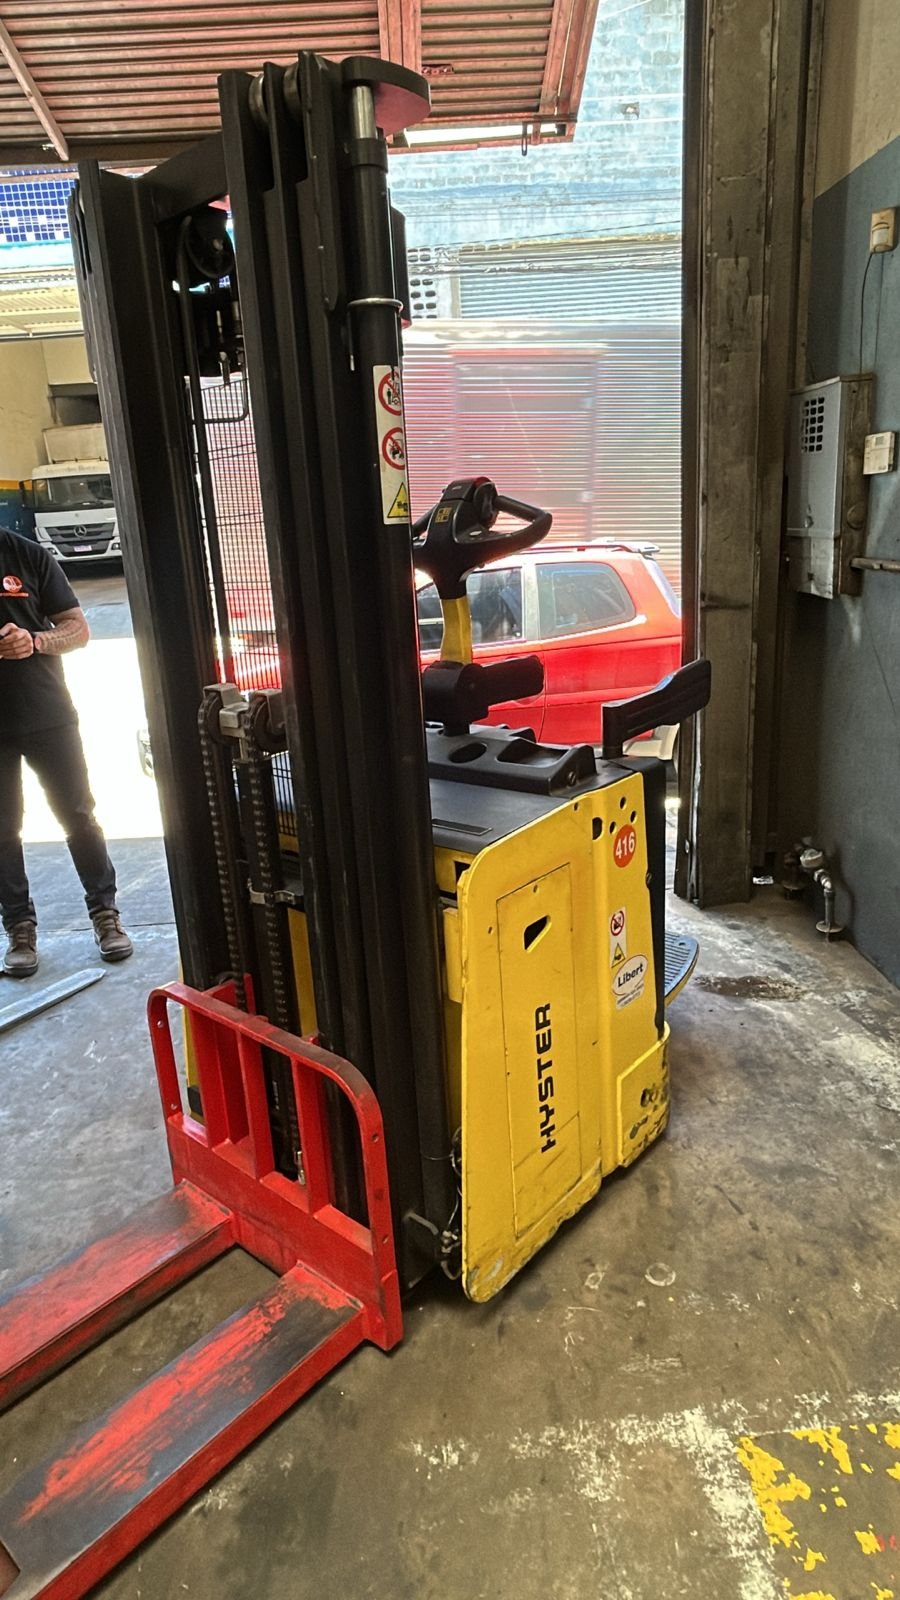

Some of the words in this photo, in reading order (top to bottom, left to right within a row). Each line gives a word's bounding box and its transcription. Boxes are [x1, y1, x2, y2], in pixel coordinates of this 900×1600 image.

[615, 831, 635, 859] 416
[617, 963, 643, 987] Libert
[534, 1003, 556, 1153] HYSTER
